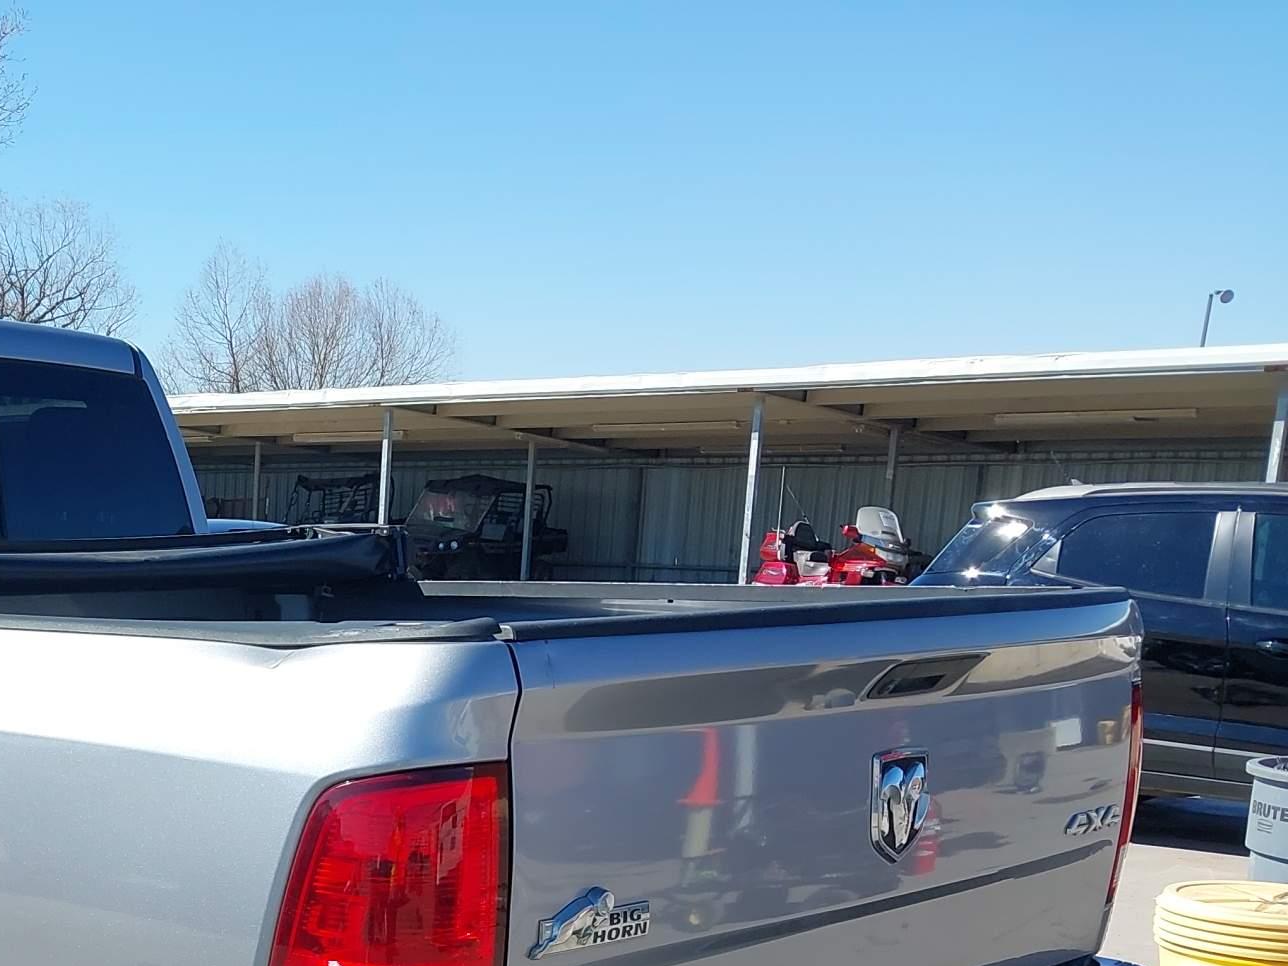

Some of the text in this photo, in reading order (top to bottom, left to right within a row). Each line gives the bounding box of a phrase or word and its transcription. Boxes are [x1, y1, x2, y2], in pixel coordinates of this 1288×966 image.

[1251, 799, 1288, 823] BRUTE
[609, 908, 642, 926] BIG
[592, 922, 648, 944] HORN
